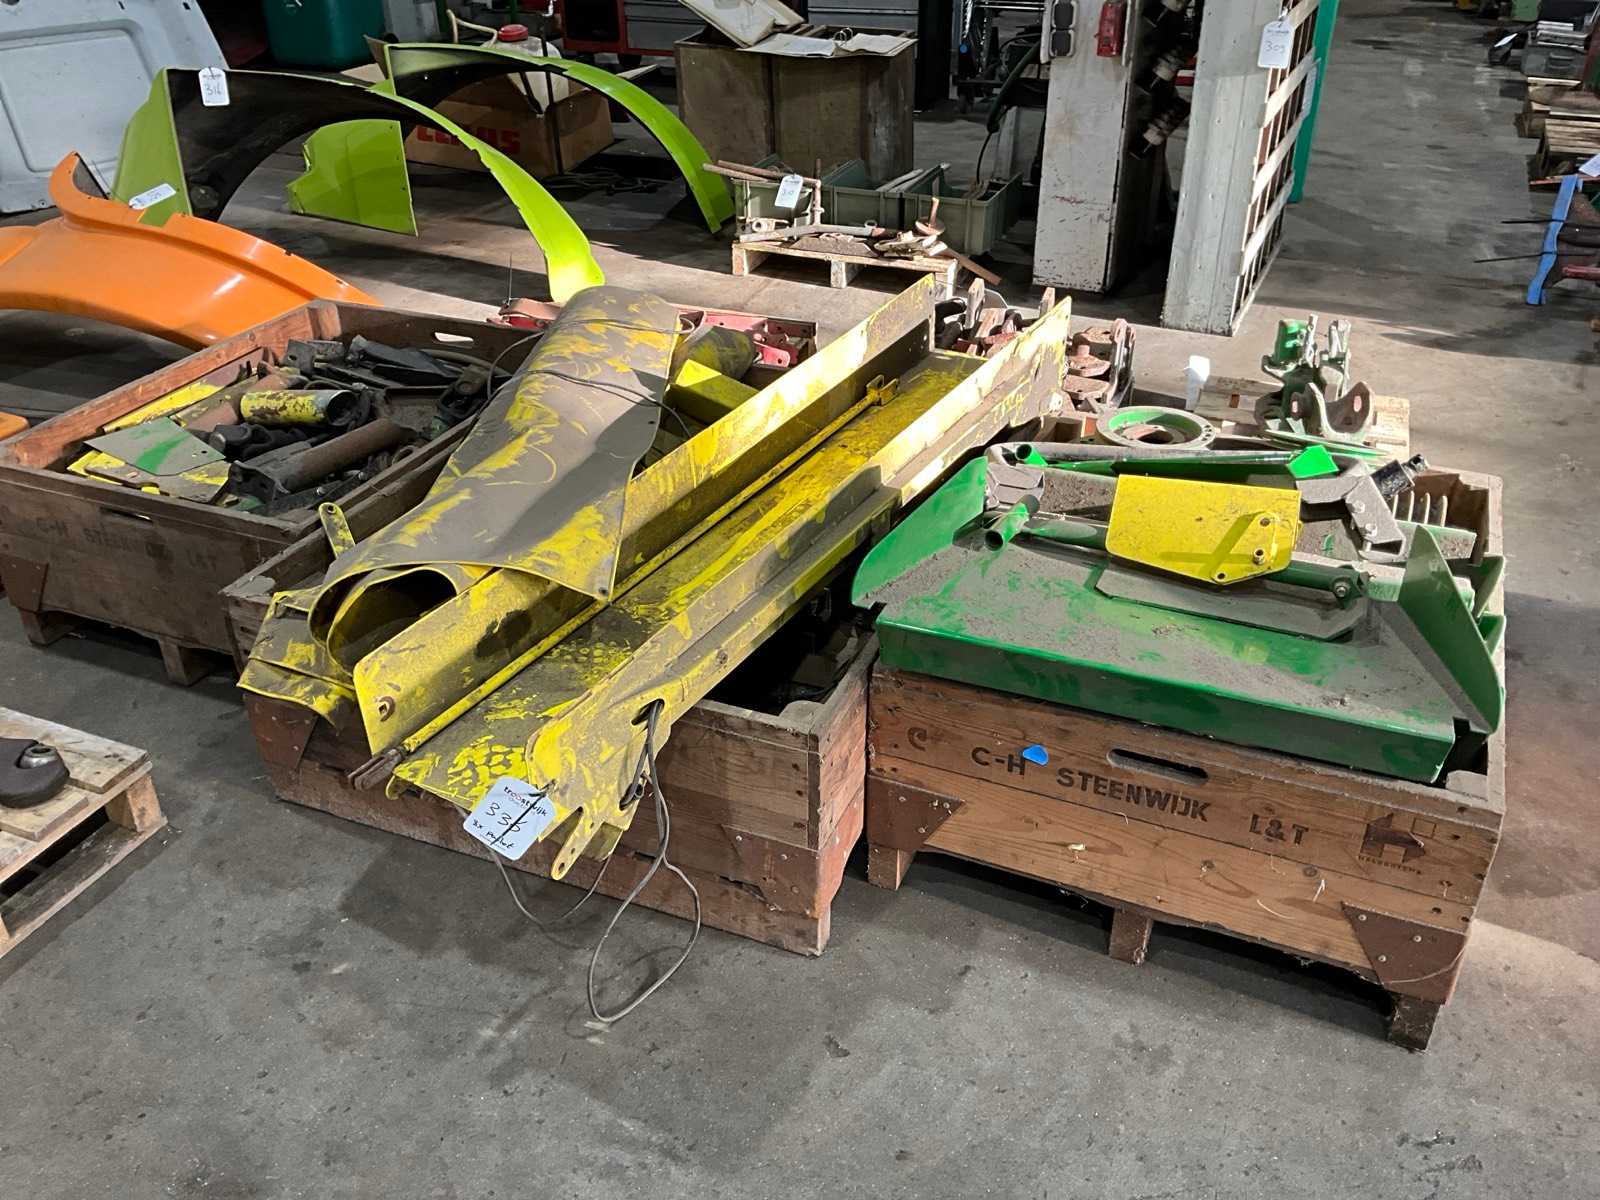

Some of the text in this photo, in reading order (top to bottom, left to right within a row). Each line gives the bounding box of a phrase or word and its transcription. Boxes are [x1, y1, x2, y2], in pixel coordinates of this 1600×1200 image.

[971, 746, 1310, 846] C-H STEENWIJK L&T
